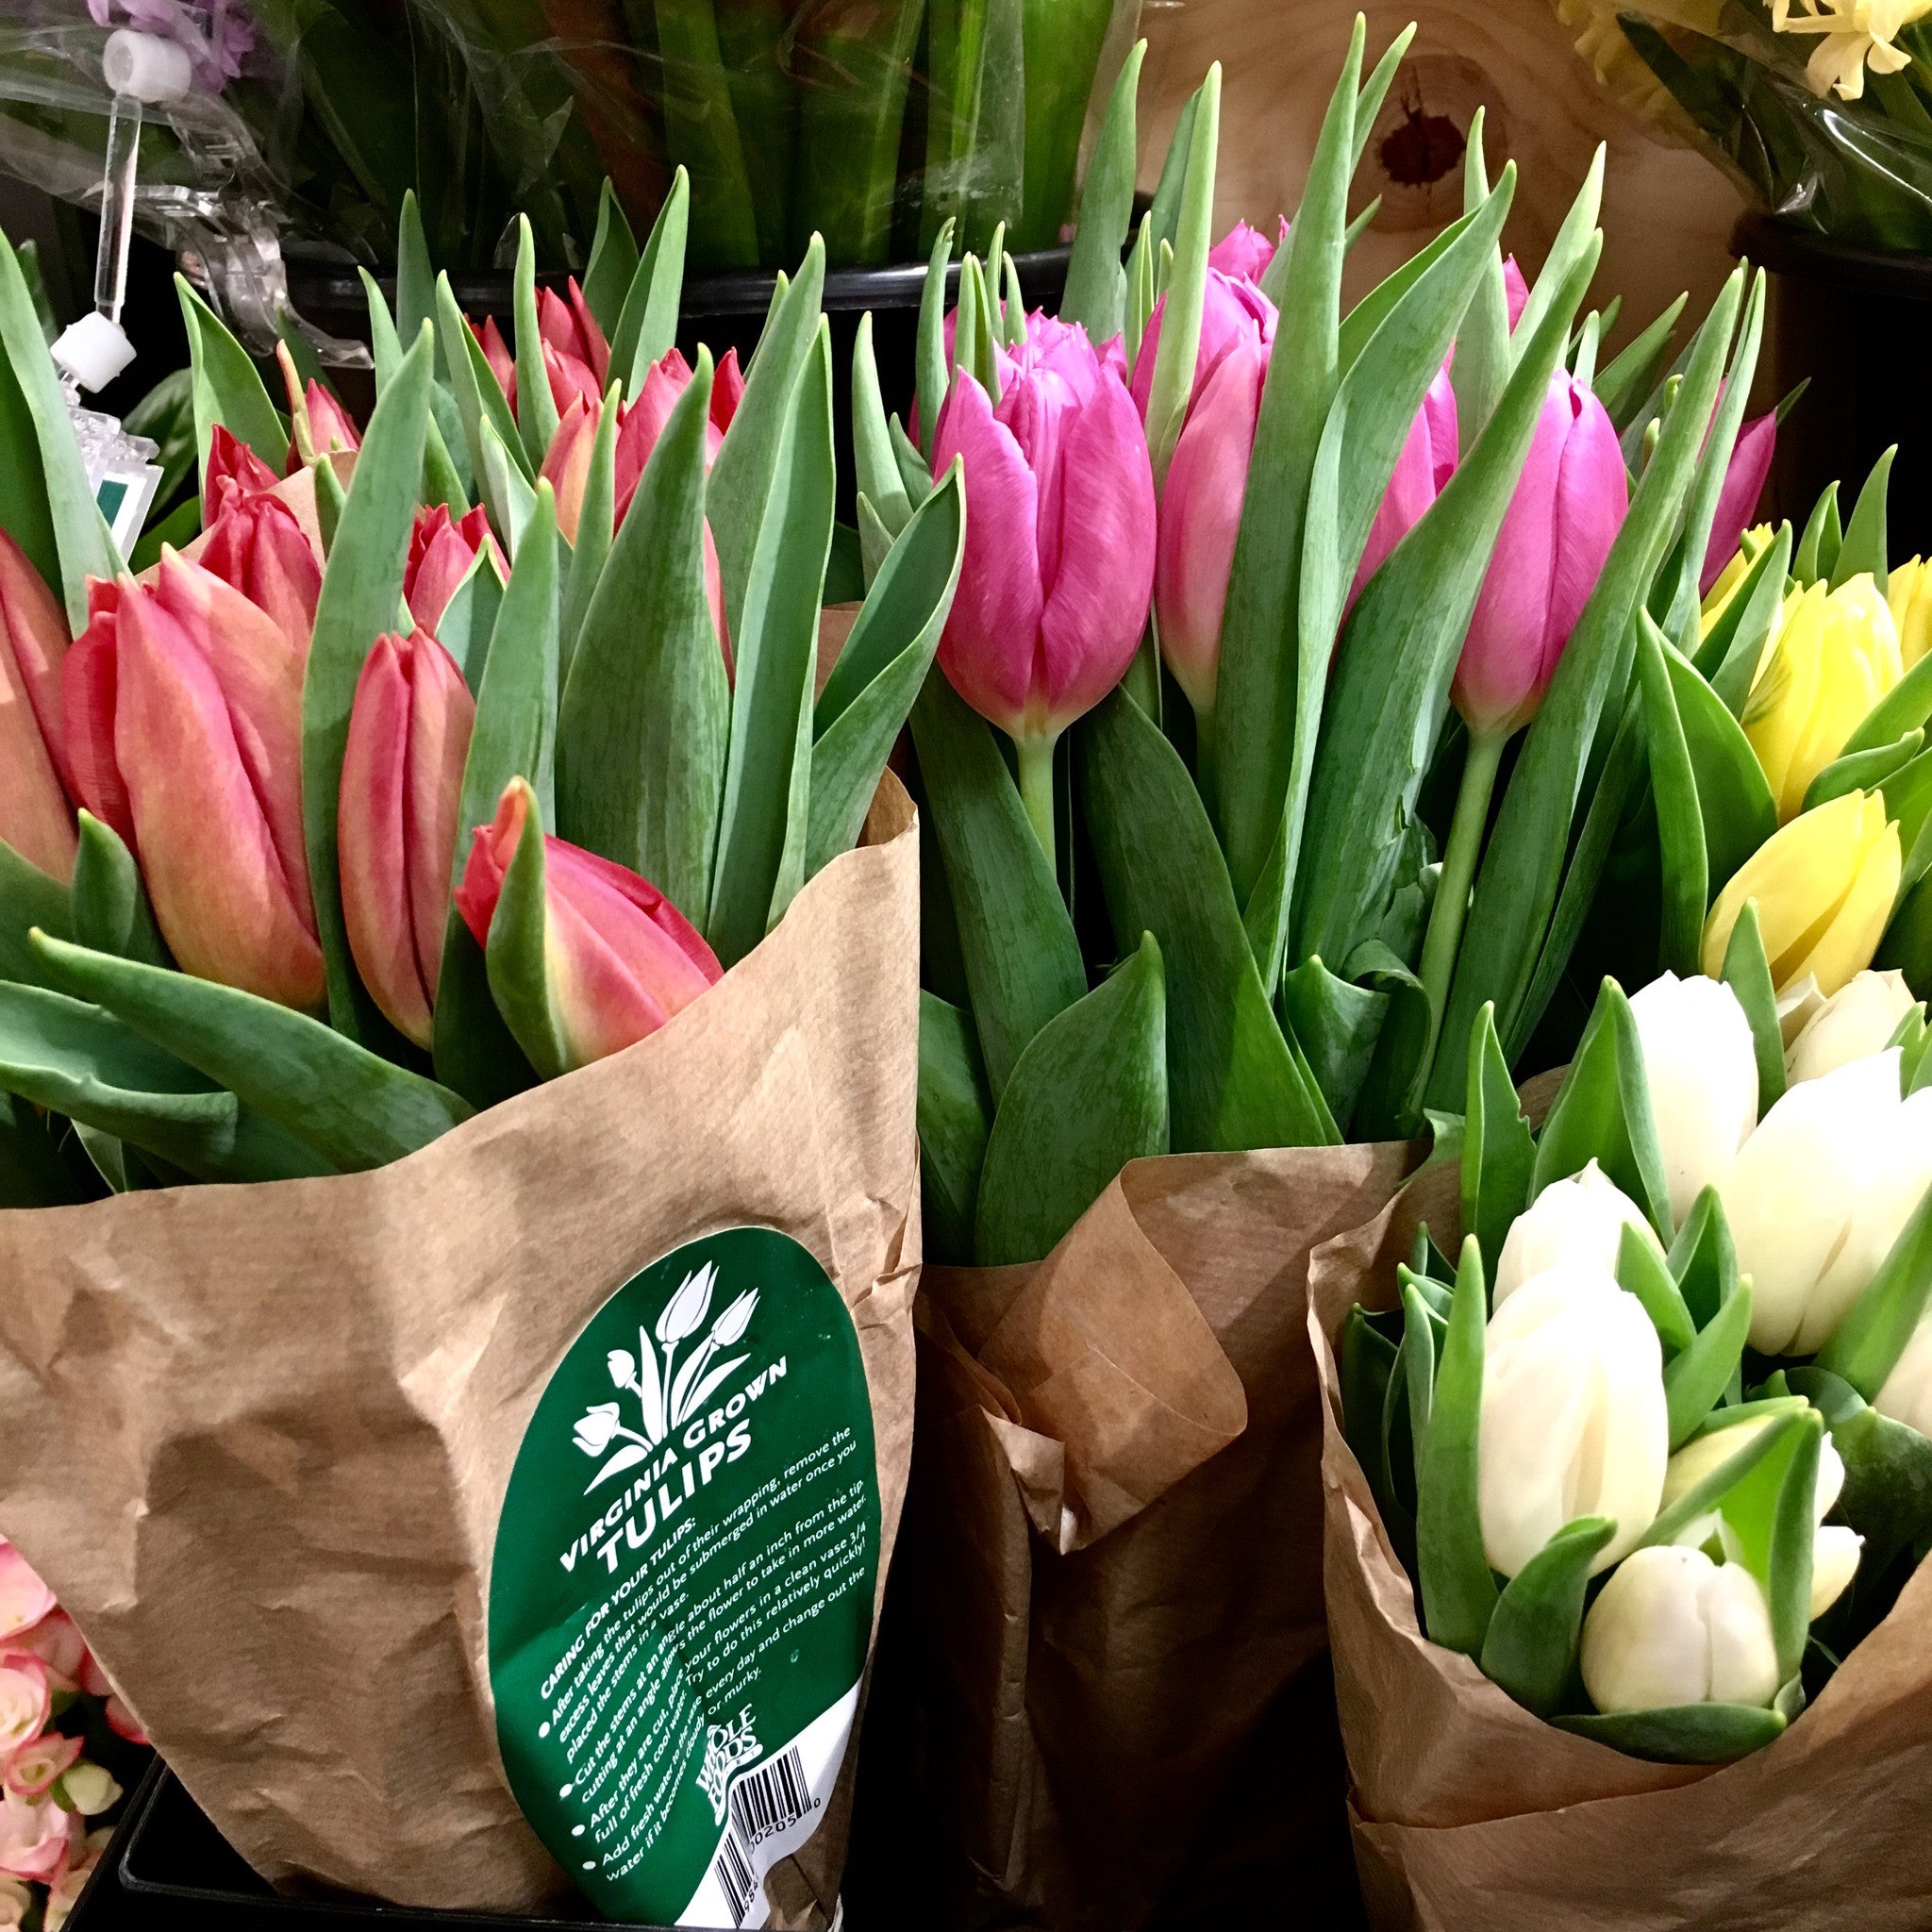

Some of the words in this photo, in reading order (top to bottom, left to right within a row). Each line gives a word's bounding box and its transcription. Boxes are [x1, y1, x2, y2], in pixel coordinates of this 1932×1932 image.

[541, 1634, 585, 1699] CARING
[585, 1602, 609, 1639] FOR
[611, 1563, 648, 1605] YOUR
[650, 1517, 696, 1566] TULIPS:
[552, 1686, 574, 1726] After
[574, 1642, 605, 1688] taking
[604, 1620, 621, 1643] the
[623, 1585, 654, 1621] tulips
[656, 1562, 675, 1585] out
[678, 1543, 691, 1565] of
[692, 1524, 719, 1552] their
[723, 1477, 780, 1526] wrapping,
[783, 1442, 829, 1479] remove
[832, 1426, 850, 1446] the
[559, 1447, 678, 1573] VIRGINIA
[683, 1356, 787, 1449] GROWN
[559, 1694, 590, 1742] excess
[587, 1652, 615, 1695] leaves
[615, 1624, 636, 1653] that
[638, 1584, 670, 1625] would
[672, 1573, 687, 1591] be
[690, 1512, 754, 1575] submerged
[757, 1504, 767, 1518] in
[769, 1478, 802, 1507] water
[806, 1457, 835, 1482] once
[837, 1440, 857, 1464] you
[596, 1418, 752, 1574] TULIPS
[567, 1707, 597, 1764] placed
[596, 1687, 611, 1711] the
[610, 1644, 637, 1688] stems
[639, 1629, 649, 1645] in
[650, 1619, 657, 1630] a
[659, 1592, 689, 1620] vase.
[575, 1757, 596, 1785] Cut
[595, 1732, 611, 1758] the
[610, 1689, 637, 1733] stems
[636, 1672, 647, 1690] at
[646, 1654, 658, 1674] an
[658, 1620, 685, 1655] angle
[688, 1587, 721, 1623] about
[724, 1561, 746, 1591] half
[749, 1553, 763, 1570] an
[766, 1531, 792, 1557] inch
[794, 1509, 824, 1534] from
[827, 1494, 847, 1513] the
[582, 1752, 618, 1803] cutting
[616, 1735, 625, 1754] at
[625, 1716, 638, 1738] an
[637, 1678, 660, 1718] angle
[661, 1640, 686, 1680] allows
[687, 1620, 706, 1641] the
[708, 1587, 743, 1622] flower
[746, 1576, 758, 1591] to
[761, 1555, 785, 1578] take
[789, 1544, 800, 1557] in
[803, 1521, 835, 1548] more
[837, 1494, 866, 1524] water.
[591, 1790, 618, 1828] After
[618, 1757, 638, 1791] they
[638, 1734, 653, 1760] are
[653, 1708, 669, 1735] cut,
[668, 1668, 683, 1709] place
[685, 1641, 711, 1673] your
[714, 1605, 756, 1644] flowers
[759, 1592, 771, 1607] in
[774, 1585, 782, 1595] a
[784, 1559, 817, 1588] clean
[820, 1539, 847, 1562] vase
[849, 1521, 866, 1545] 3/4
[595, 1815, 618, 1843] full
[620, 1794, 630, 1820] of
[629, 1762, 653, 1802] fresh
[654, 1726, 671, 1763] cool
[670, 1690, 687, 1730] water.
[685, 1669, 704, 1686] Try
[707, 1656, 720, 1671] to
[723, 1640, 738, 1657] do
[741, 1618, 763, 1641] this
[766, 1574, 820, 1620] relatively
[824, 1536, 866, 1579] quickly!
[603, 1835, 630, 1866] Add
[631, 1803, 655, 1840] fresh
[653, 1763, 673, 1804] water
[672, 1749, 680, 1766] to
[706, 1668, 734, 1698] every
[737, 1649, 756, 1671] day
[758, 1627, 780, 1653] and
[782, 1599, 825, 1633] change
[827, 1582, 847, 1602] out
[848, 1567, 865, 1586] the
[607, 1846, 644, 1881] water
[645, 1828, 654, 1849] if
[654, 1821, 662, 1836] it
[660, 1758, 687, 1823] becomes
[686, 1712, 705, 1758] cloudy
[708, 1701, 722, 1715] or
[724, 1666, 761, 1703] murky.
[813, 1797, 822, 1808] 0
